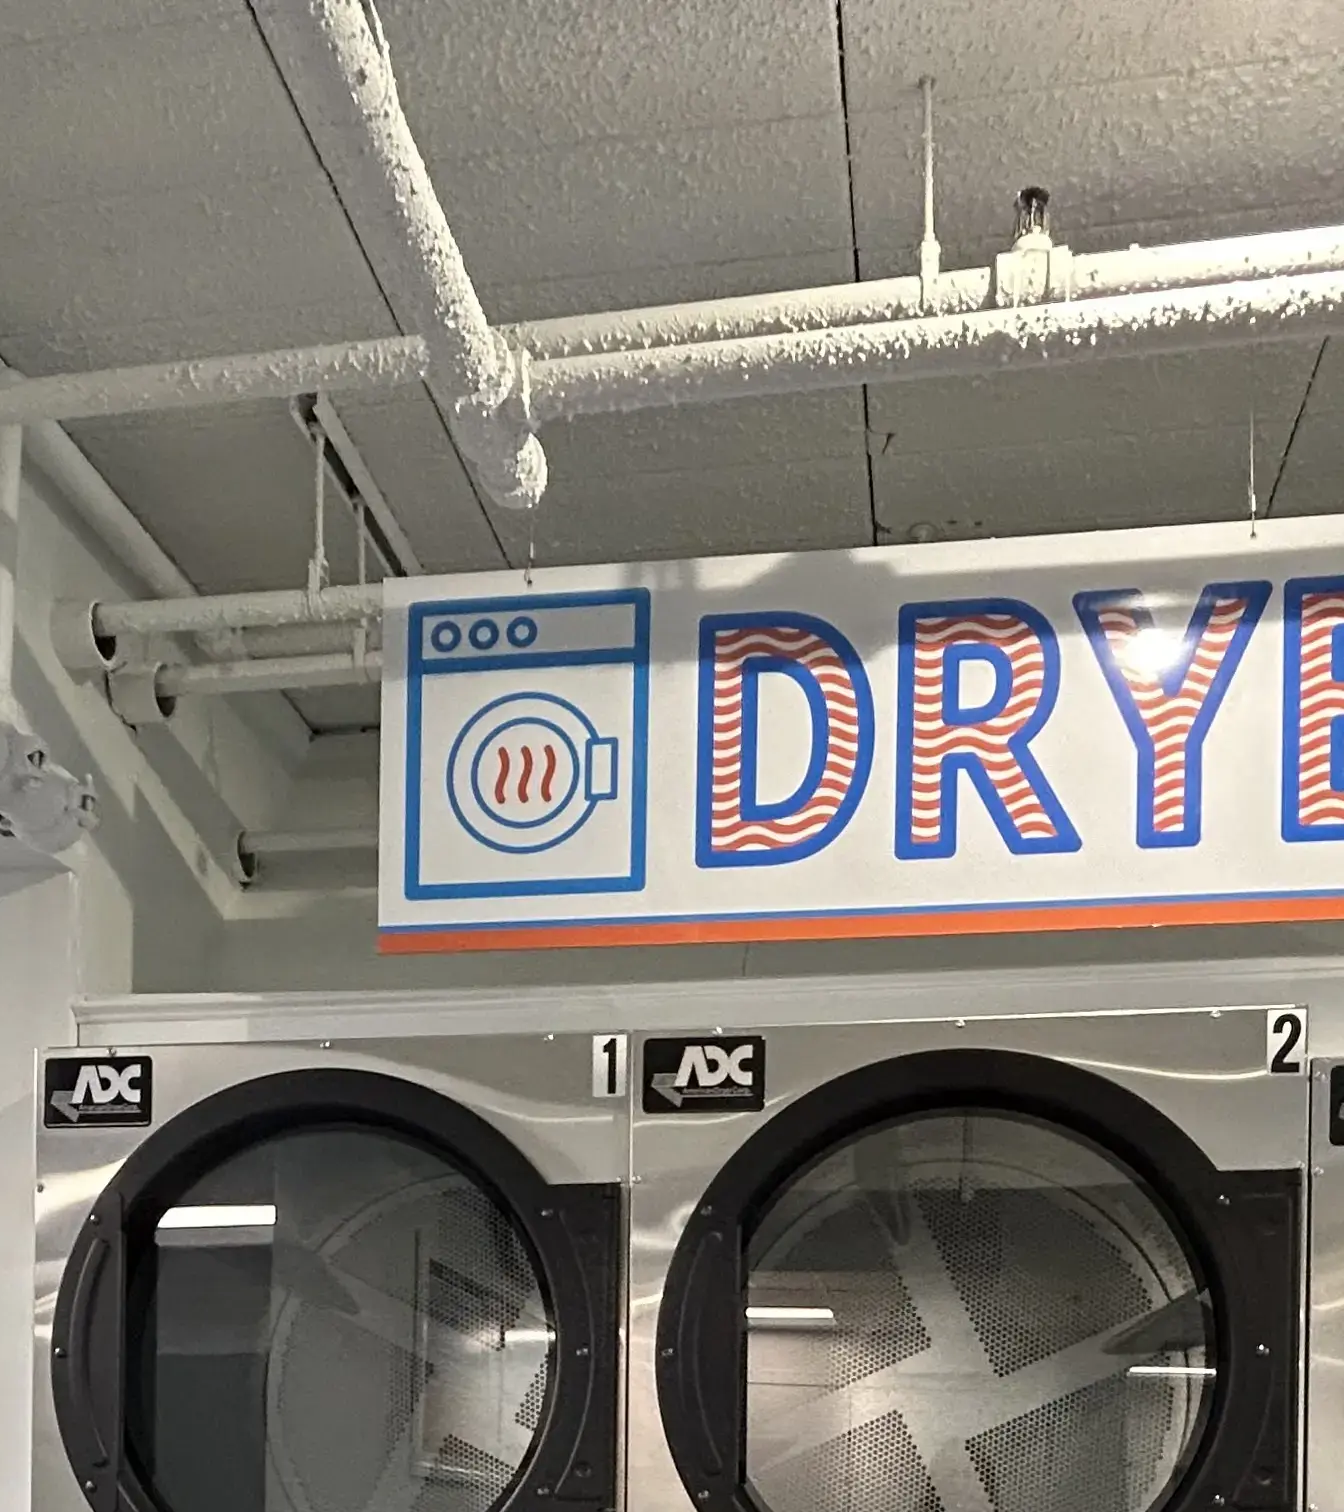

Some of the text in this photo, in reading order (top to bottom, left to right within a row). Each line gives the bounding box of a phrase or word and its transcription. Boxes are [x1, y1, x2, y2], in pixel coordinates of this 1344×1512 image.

[602, 1038, 618, 1095] 1
[674, 1044, 754, 1088] ADC
[1270, 1012, 1304, 1074] 2
[71, 1063, 142, 1105] ADC
